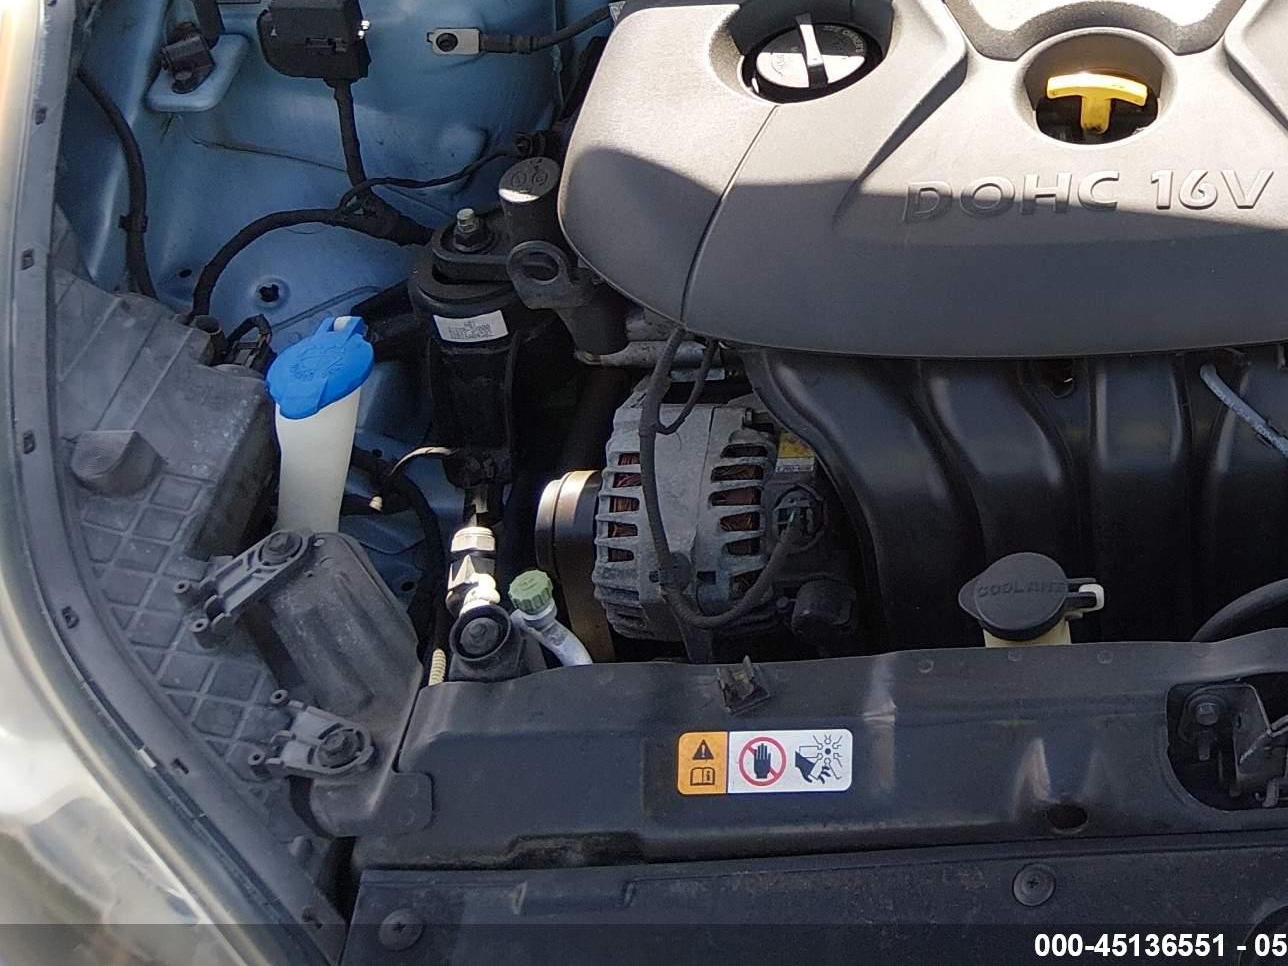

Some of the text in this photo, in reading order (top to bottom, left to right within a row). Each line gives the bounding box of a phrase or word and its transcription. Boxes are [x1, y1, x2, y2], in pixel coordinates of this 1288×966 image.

[902, 169, 1274, 222] DOHC 16V
[977, 580, 1066, 598] COOLANT
